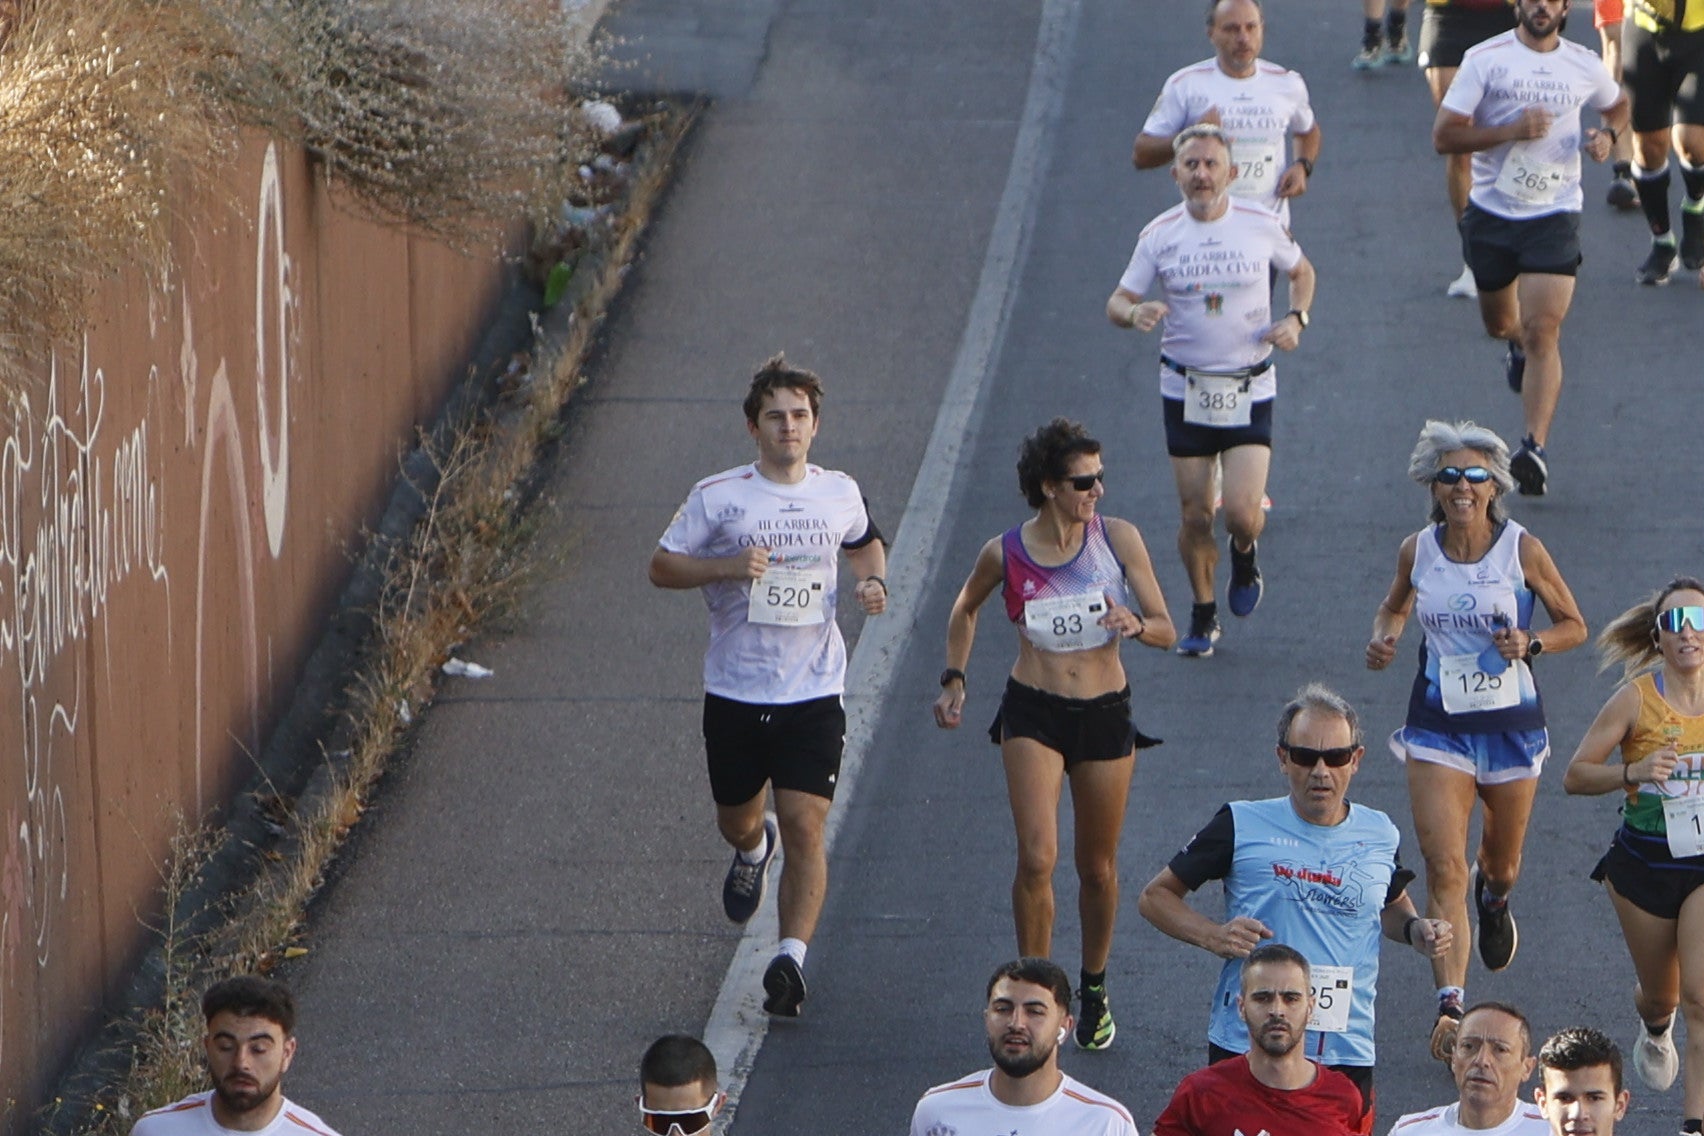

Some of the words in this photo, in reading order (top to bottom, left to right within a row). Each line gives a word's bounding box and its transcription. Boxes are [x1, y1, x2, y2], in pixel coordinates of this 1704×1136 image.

[1238, 161, 1265, 179] 78
[1512, 166, 1550, 192] 265
[1198, 391, 1238, 410] 383
[758, 519, 771, 531] III
[774, 518, 829, 531] CARRERA
[766, 585, 811, 609] 520
[1052, 613, 1084, 637] 83
[1420, 611, 1496, 629] INFINIT
[1458, 671, 1503, 695] 125
